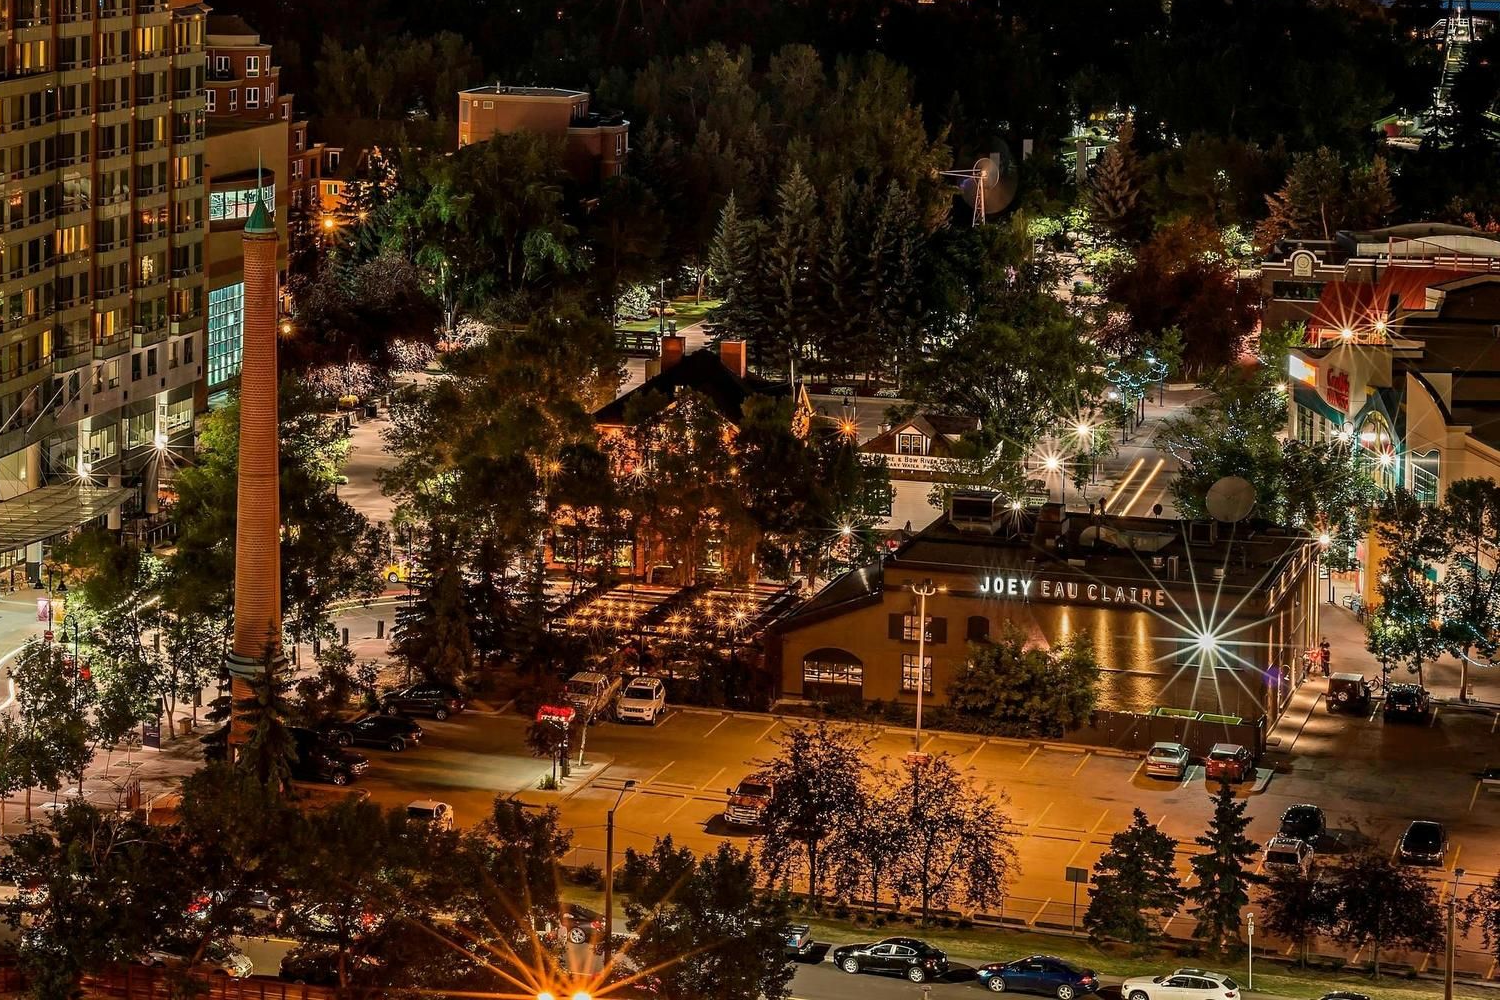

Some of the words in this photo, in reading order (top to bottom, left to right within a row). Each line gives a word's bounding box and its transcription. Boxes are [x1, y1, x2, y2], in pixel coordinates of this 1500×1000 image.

[980, 576, 1032, 596] JOEY
[1040, 580, 1078, 599] EAU
[1087, 584, 1165, 606] CLAIRE
